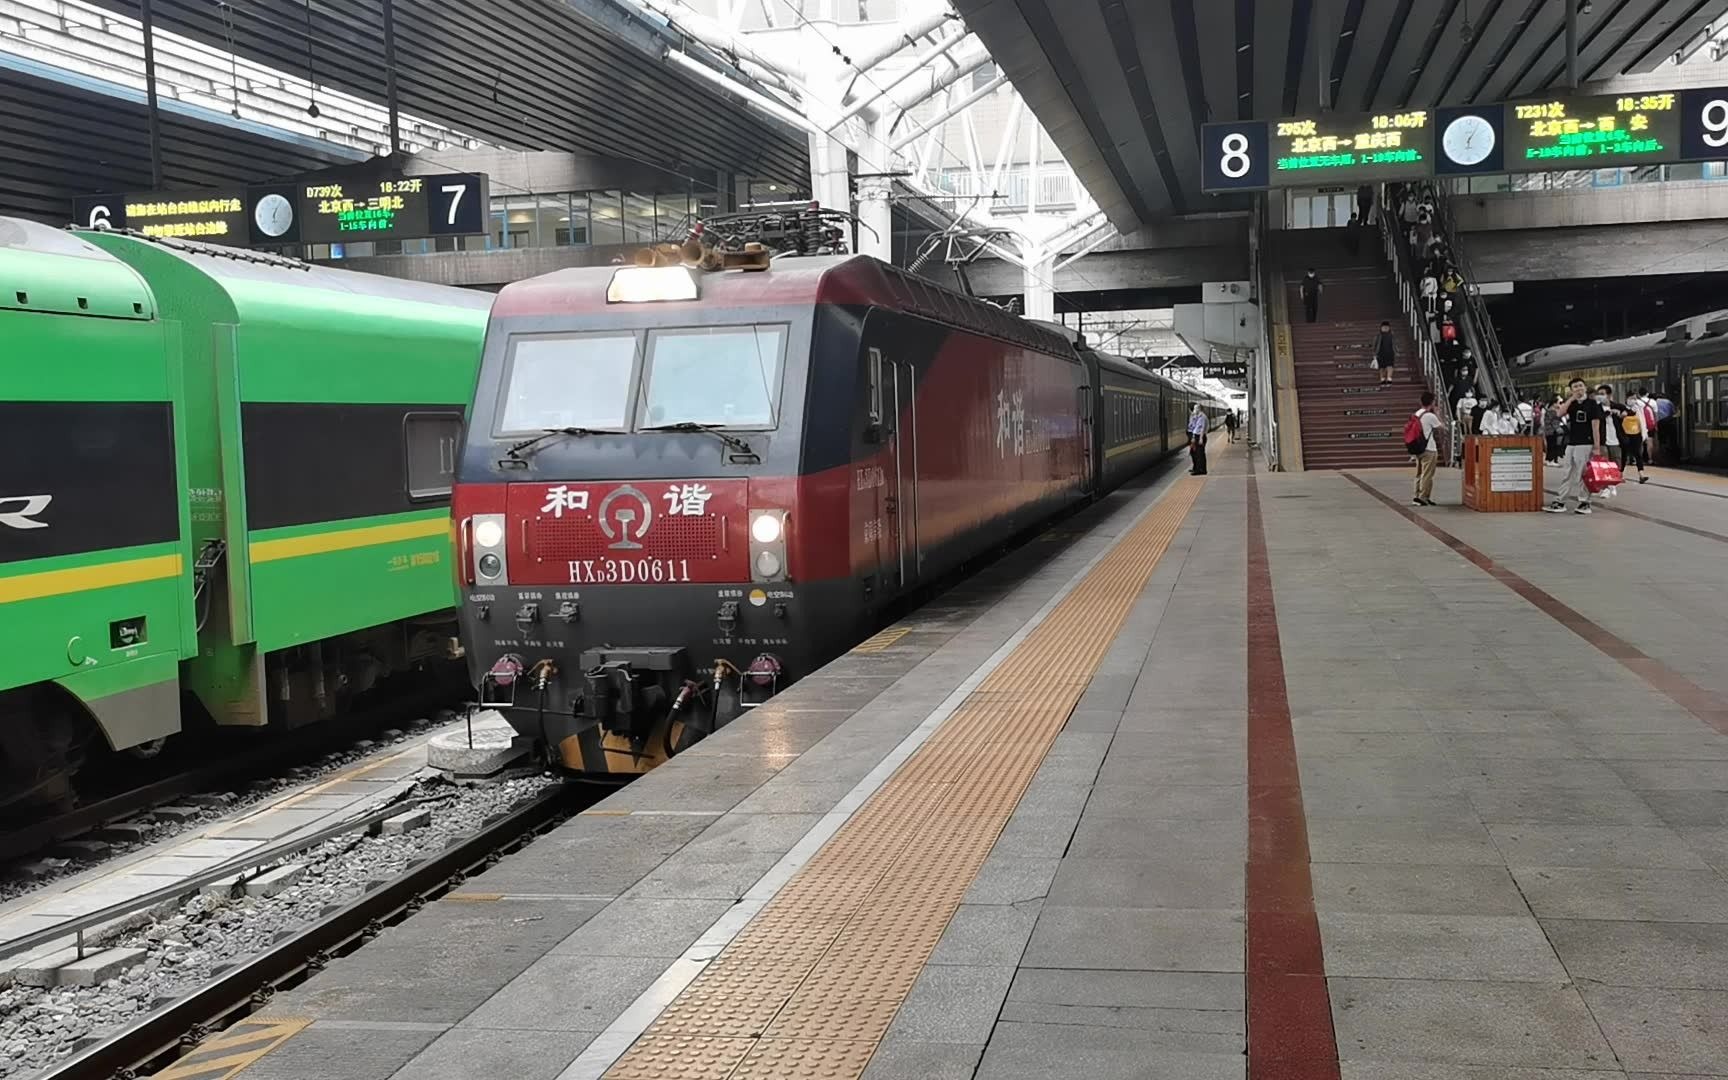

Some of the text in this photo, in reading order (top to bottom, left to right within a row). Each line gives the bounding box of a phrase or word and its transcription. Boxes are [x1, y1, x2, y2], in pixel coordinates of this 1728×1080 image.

[1515, 93, 1675, 119] T231次 18:35开
[1530, 118, 1580, 137] 北京西
[1702, 99, 1728, 147] 9
[1220, 133, 1251, 178] 8
[1291, 136, 1338, 153] 北京西
[379, 178, 423, 193] 18:22开
[318, 195, 404, 214] 北京西 三明北
[441, 184, 466, 225] 7
[540, 483, 713, 518] 和 谐
